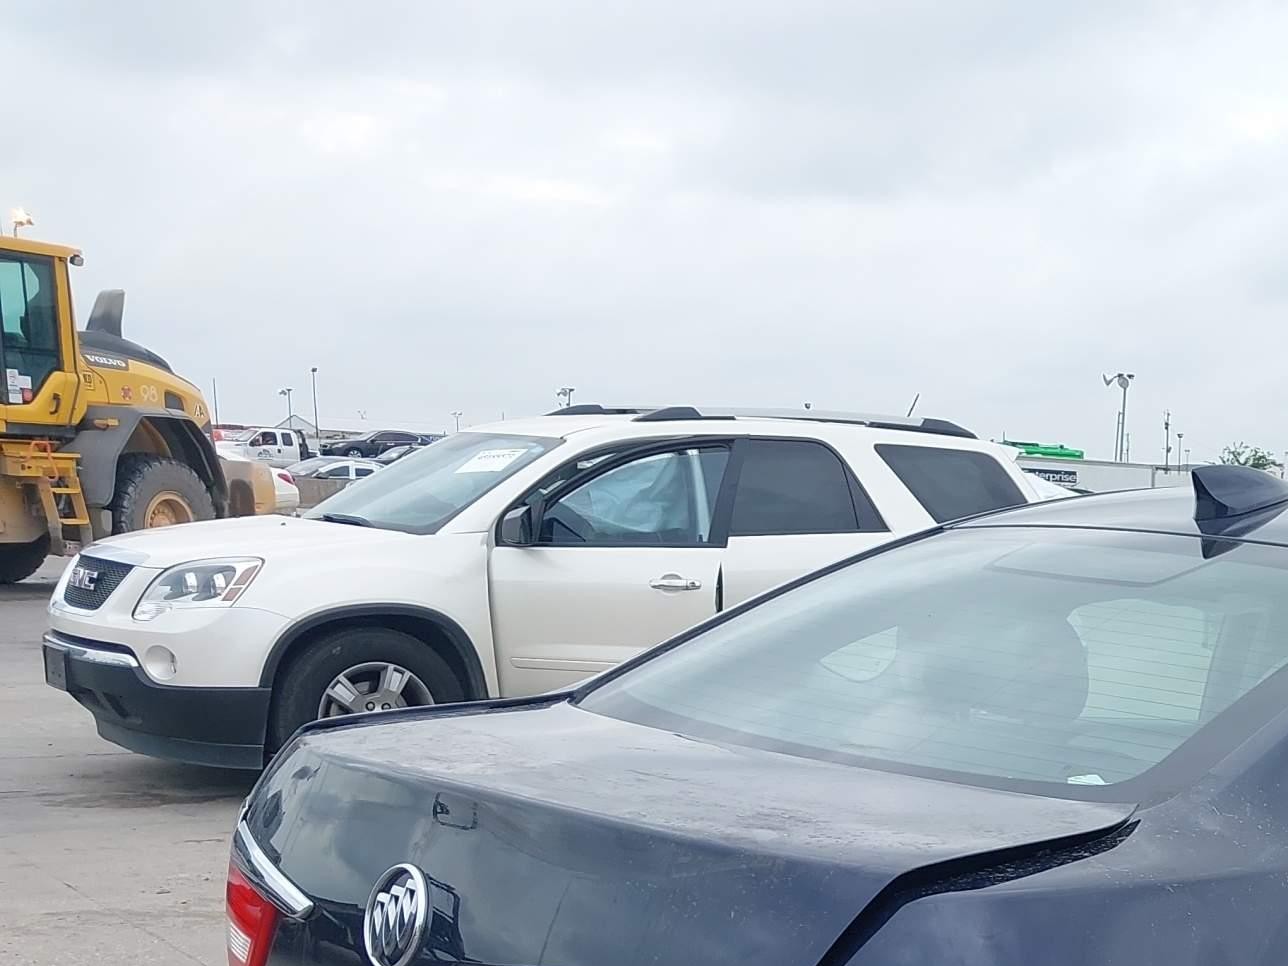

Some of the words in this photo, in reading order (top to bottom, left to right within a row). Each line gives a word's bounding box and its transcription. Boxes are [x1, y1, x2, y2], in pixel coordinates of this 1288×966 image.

[83, 354, 127, 368] VOLVO
[140, 384, 158, 402] 98
[1034, 471, 1077, 483] erprise
